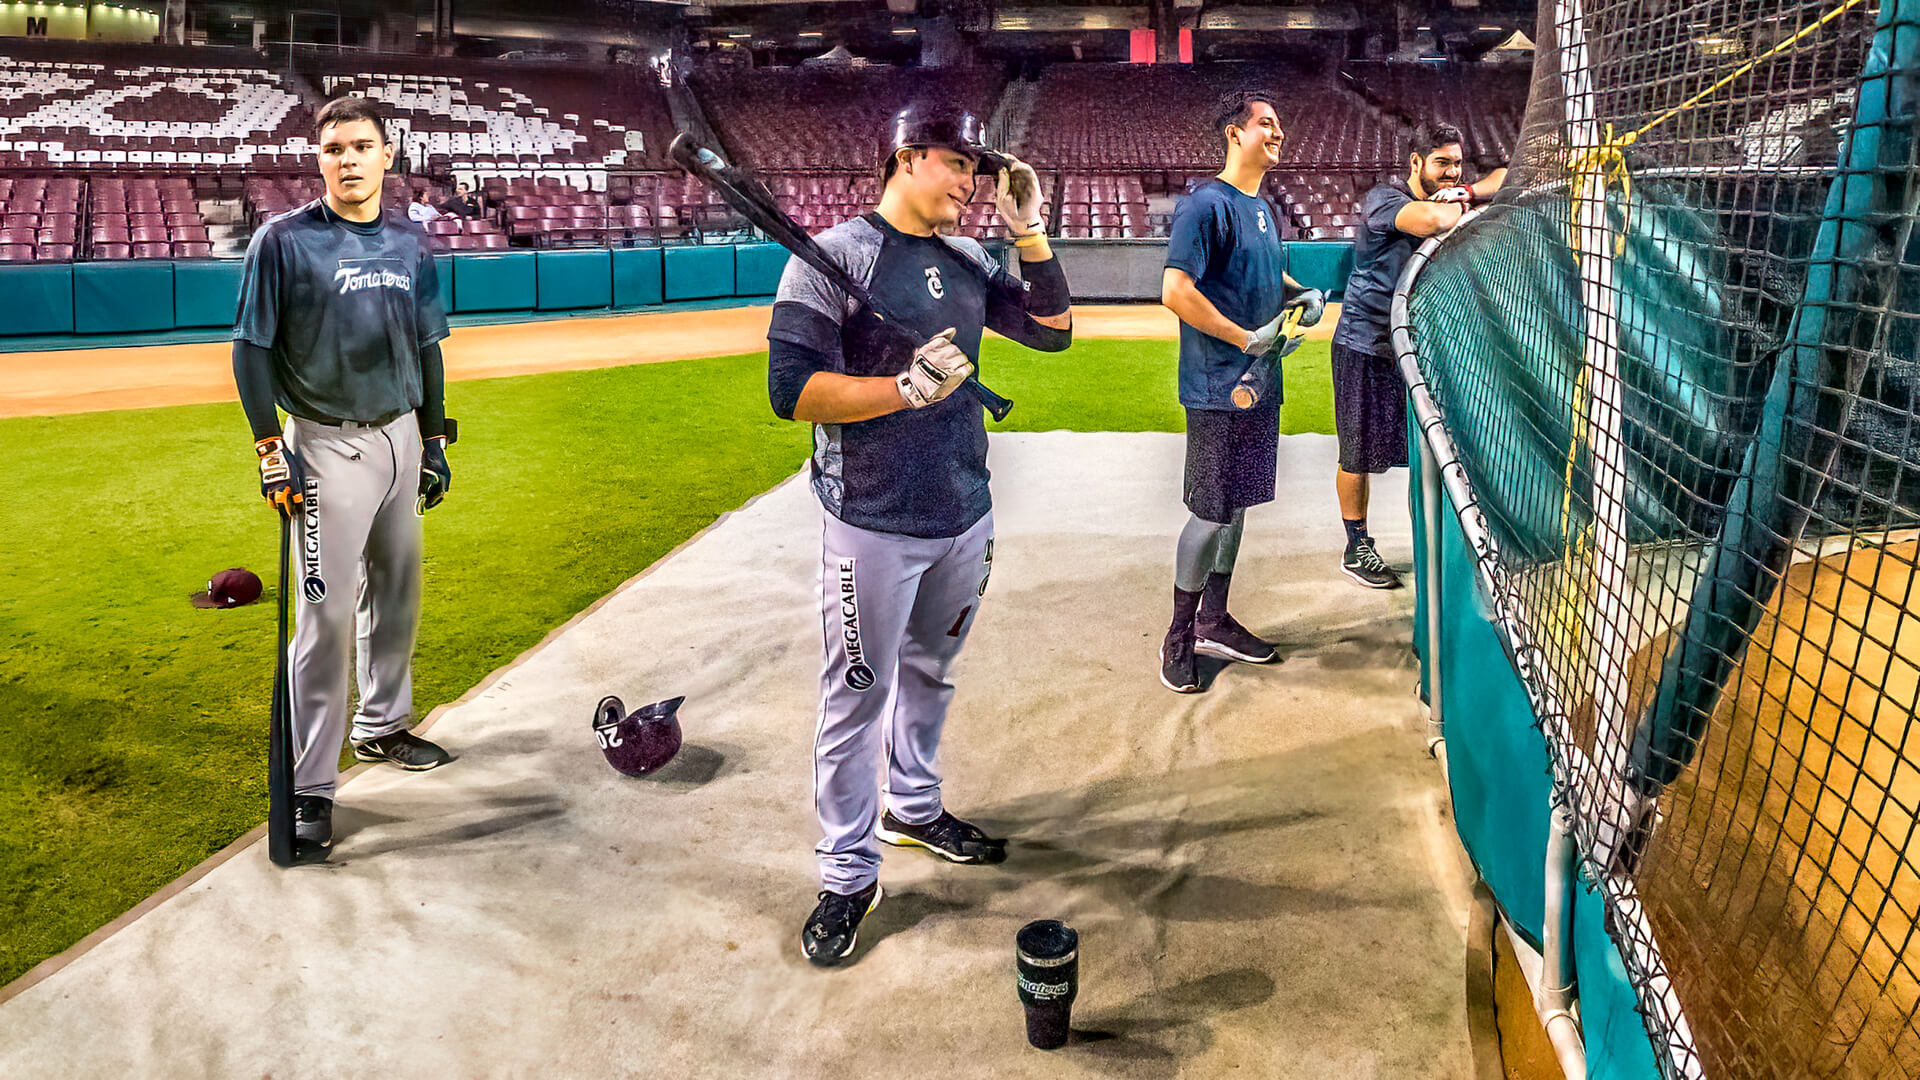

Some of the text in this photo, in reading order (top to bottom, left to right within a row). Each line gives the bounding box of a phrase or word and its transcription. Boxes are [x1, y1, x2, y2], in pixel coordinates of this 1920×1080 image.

[26, 16, 48, 36] M
[334, 265, 411, 295] Tomateros
[306, 479, 320, 577] MEGACABLE
[840, 560, 863, 665] MEGACABLE
[595, 726, 624, 750] 20
